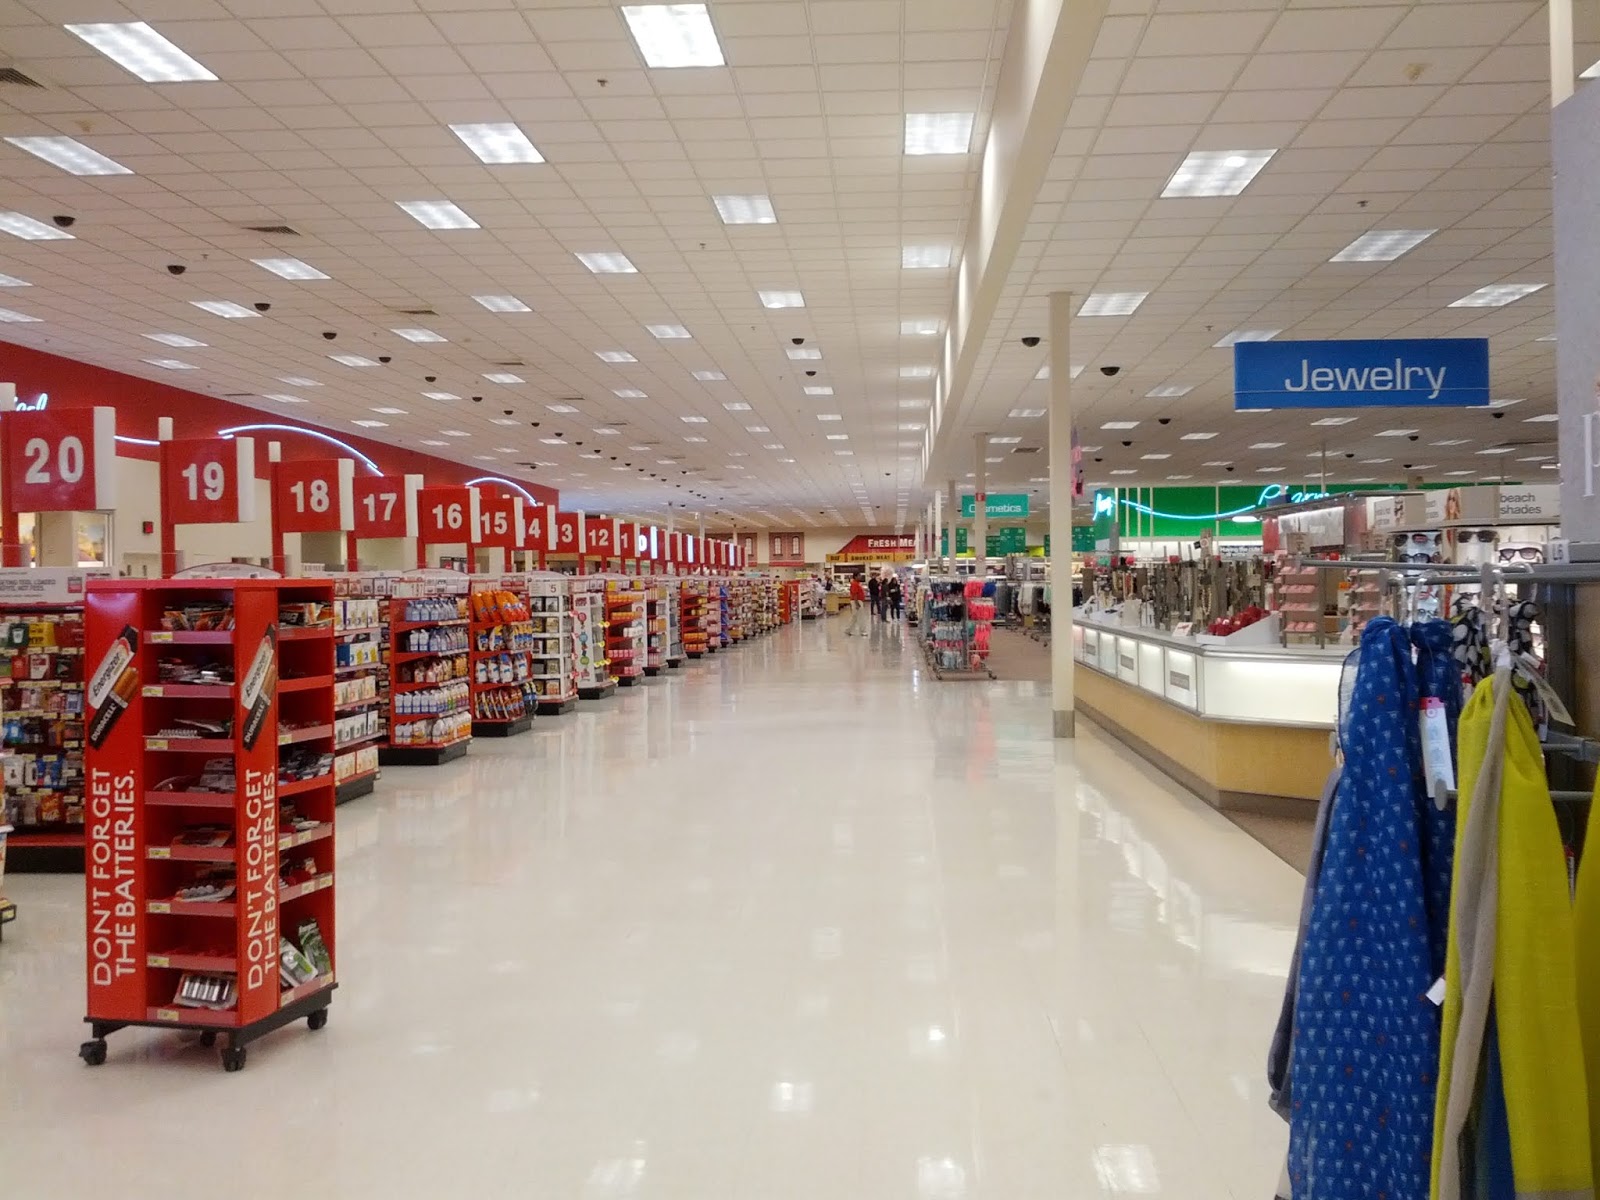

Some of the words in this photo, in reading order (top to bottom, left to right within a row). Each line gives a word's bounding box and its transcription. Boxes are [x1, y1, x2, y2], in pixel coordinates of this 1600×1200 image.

[1285, 357, 1447, 400] Jewelry
[24, 436, 85, 485] 20
[182, 461, 226, 501] 19
[290, 479, 330, 513] 18
[363, 492, 398, 522] 17
[432, 503, 463, 530] 16
[480, 511, 508, 535] 15
[969, 503, 1022, 513] Csmetics
[1500, 504, 1542, 515] shades
[528, 518, 541, 539] 4
[561, 523, 573, 543] 3
[588, 528, 609, 547] 12
[621, 532, 628, 549] 1
[868, 538, 897, 548] FRESH
[900, 538, 916, 548] MEA
[92, 652, 120, 697] Energizer
[91, 702, 117, 741] DURACELL
[244, 700, 265, 743] DURACELL
[92, 767, 111, 879] FORGET
[114, 769, 136, 917] BATTERIES.
[245, 768, 262, 883] FORGET
[263, 765, 276, 913] BATTERIES.
[93, 886, 112, 986] DON'T
[115, 922, 136, 977] THE
[247, 890, 263, 990] DON'T
[264, 917, 276, 974] THE
